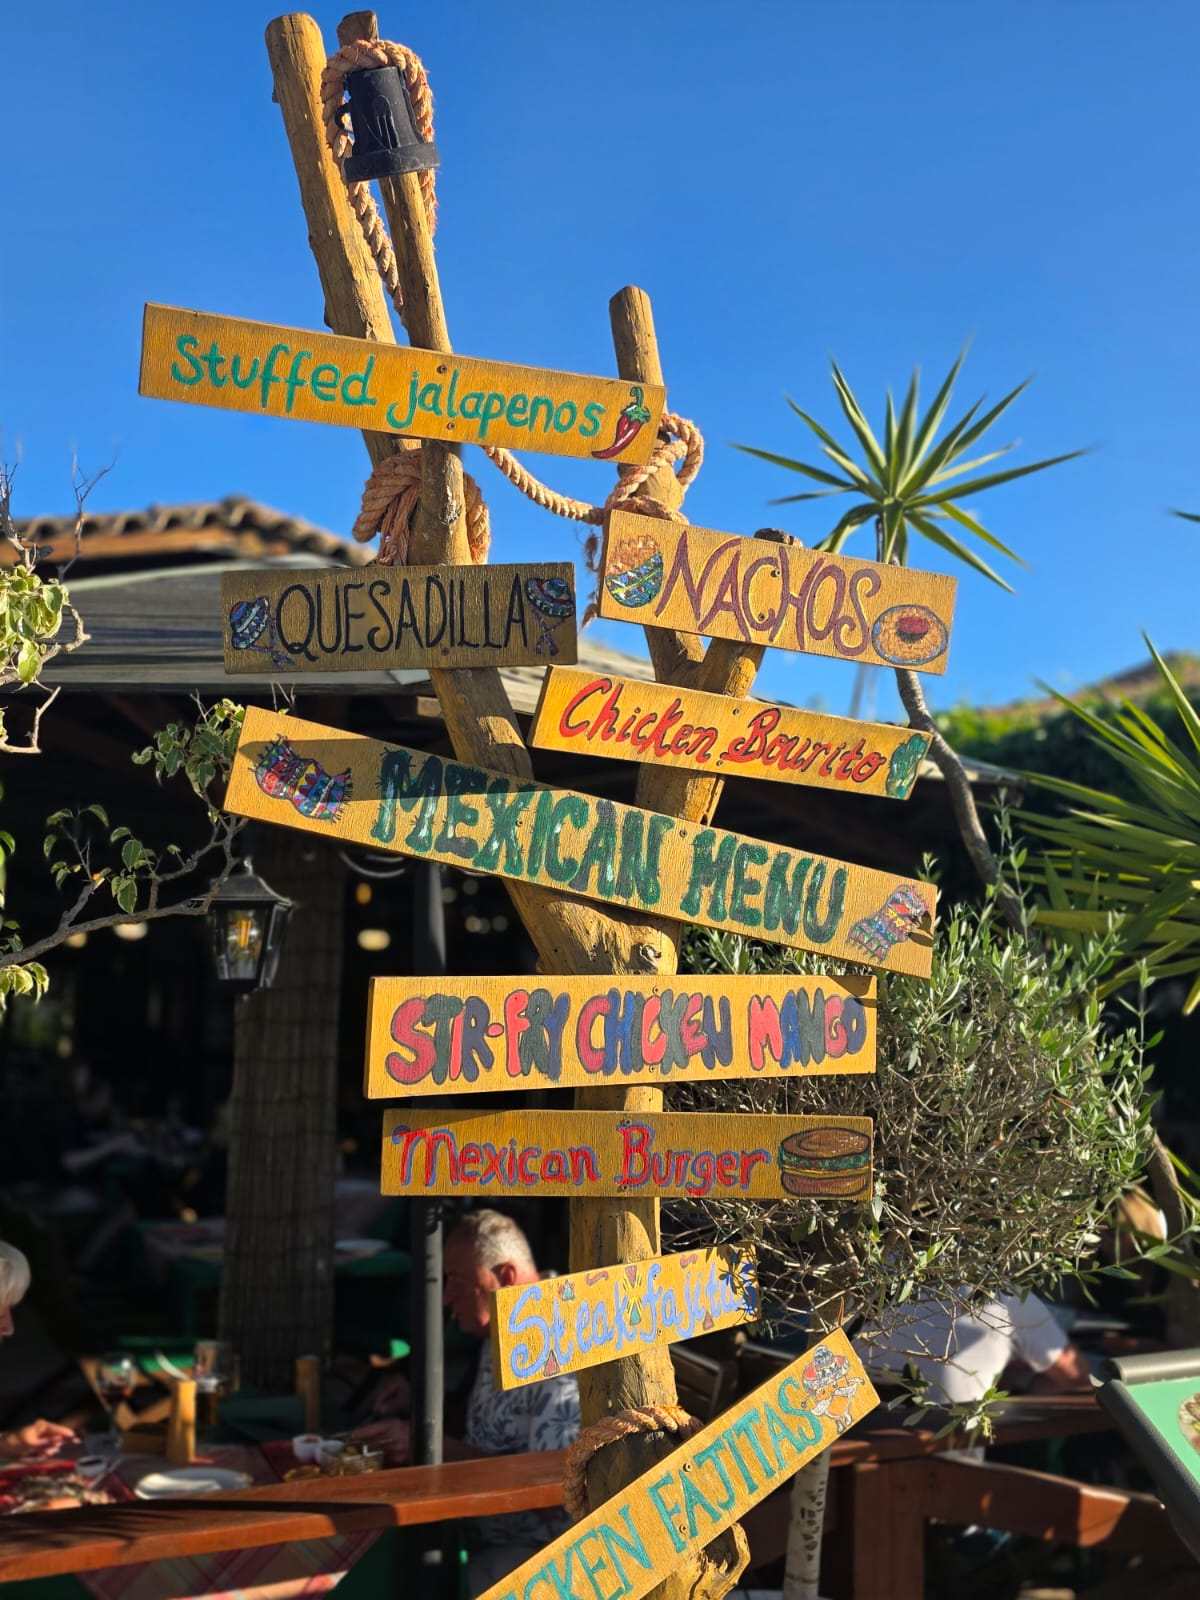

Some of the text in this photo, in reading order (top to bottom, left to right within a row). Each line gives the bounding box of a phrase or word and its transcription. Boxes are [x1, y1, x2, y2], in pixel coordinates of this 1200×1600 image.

[172, 335, 606, 438] Stuffed jalapenos
[276, 573, 528, 661] QUESADILLA
[655, 531, 882, 656] NACHOS
[559, 678, 718, 762] Chicken
[370, 747, 849, 943] MEXICAN MENU
[385, 987, 867, 1085] STIR-FRY CHICKEN MANGO
[391, 1122, 771, 1196] Mexican Burger
[508, 1285, 635, 1379] Steak
[647, 1376, 823, 1553] FAJITAS
